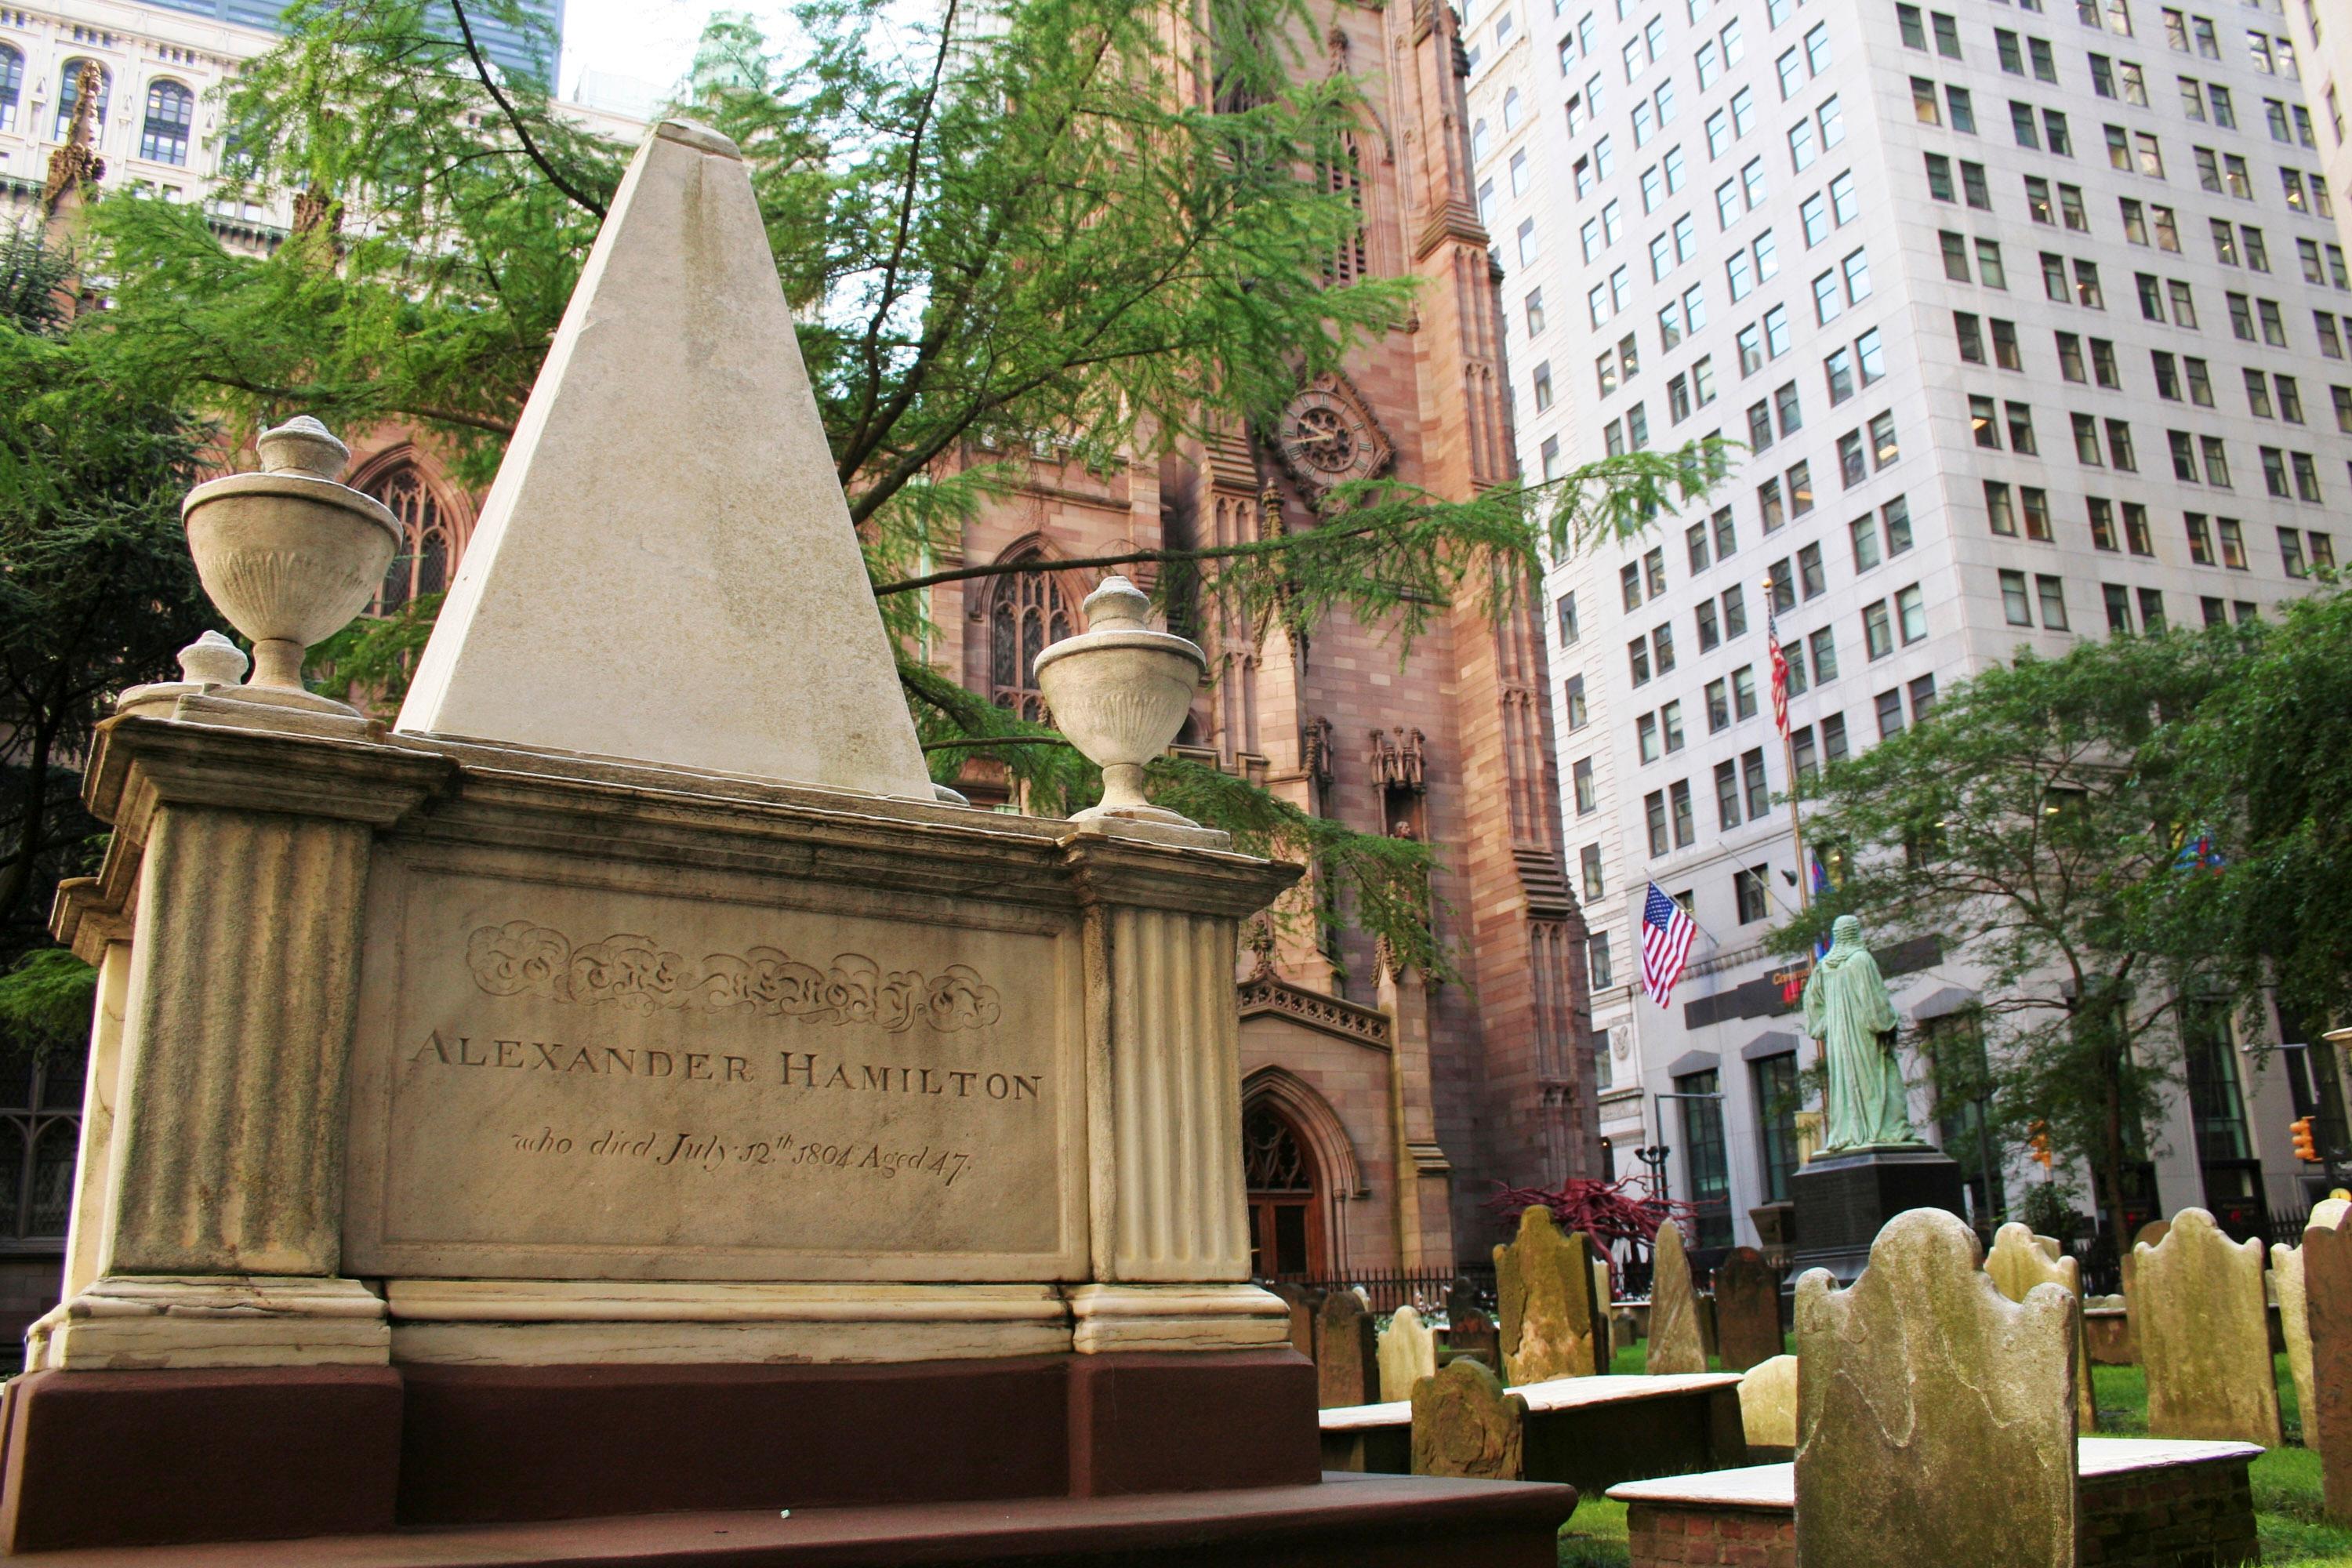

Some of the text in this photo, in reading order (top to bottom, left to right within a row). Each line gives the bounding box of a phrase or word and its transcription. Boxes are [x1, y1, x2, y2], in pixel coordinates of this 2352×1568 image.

[406, 1027, 1044, 1101] ALEXANDER HAMILTON
[511, 1126, 573, 1155] who
[590, 1130, 656, 1156] died
[858, 1143, 929, 1179] Aged
